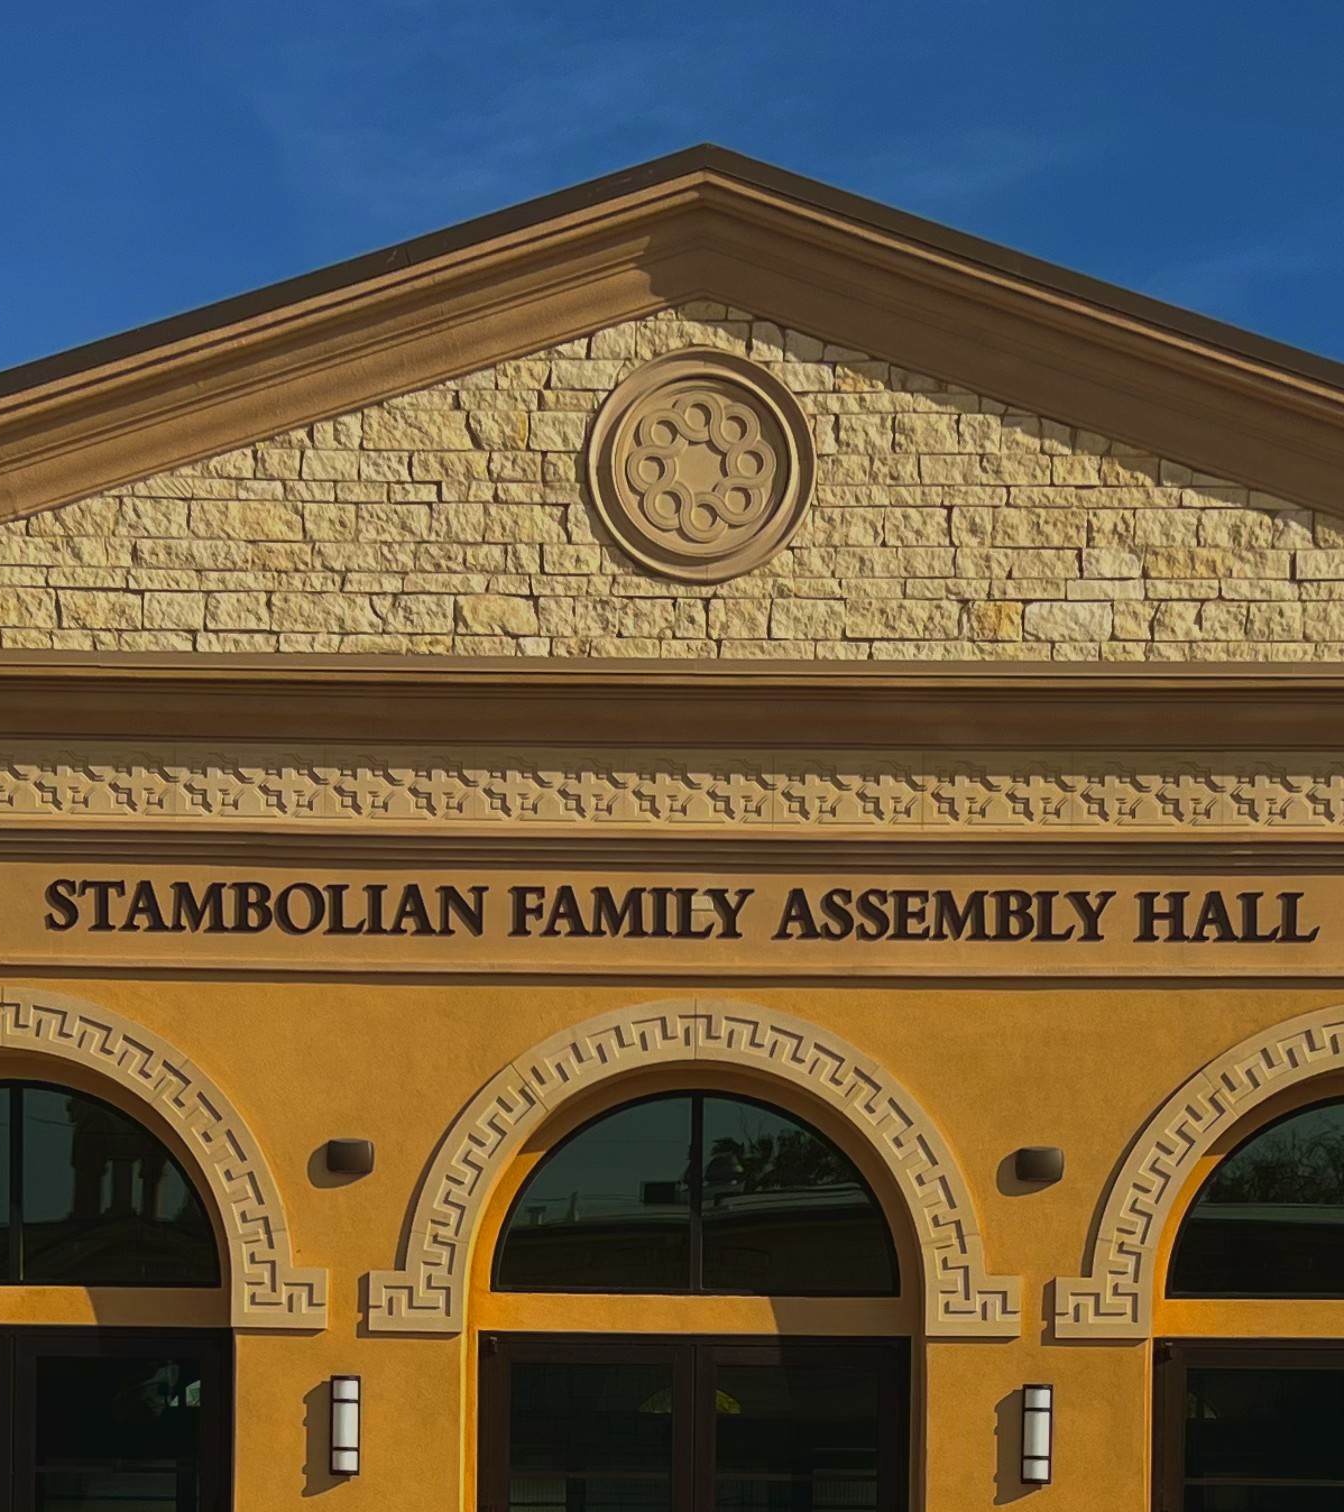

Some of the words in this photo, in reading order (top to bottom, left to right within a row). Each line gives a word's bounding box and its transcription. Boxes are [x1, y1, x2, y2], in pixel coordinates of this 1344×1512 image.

[43, 879, 490, 937] STAMBOLIAN
[507, 885, 754, 940] FAMILY
[771, 887, 1117, 942] ASSEMBLY
[1133, 890, 1320, 943] HALL
